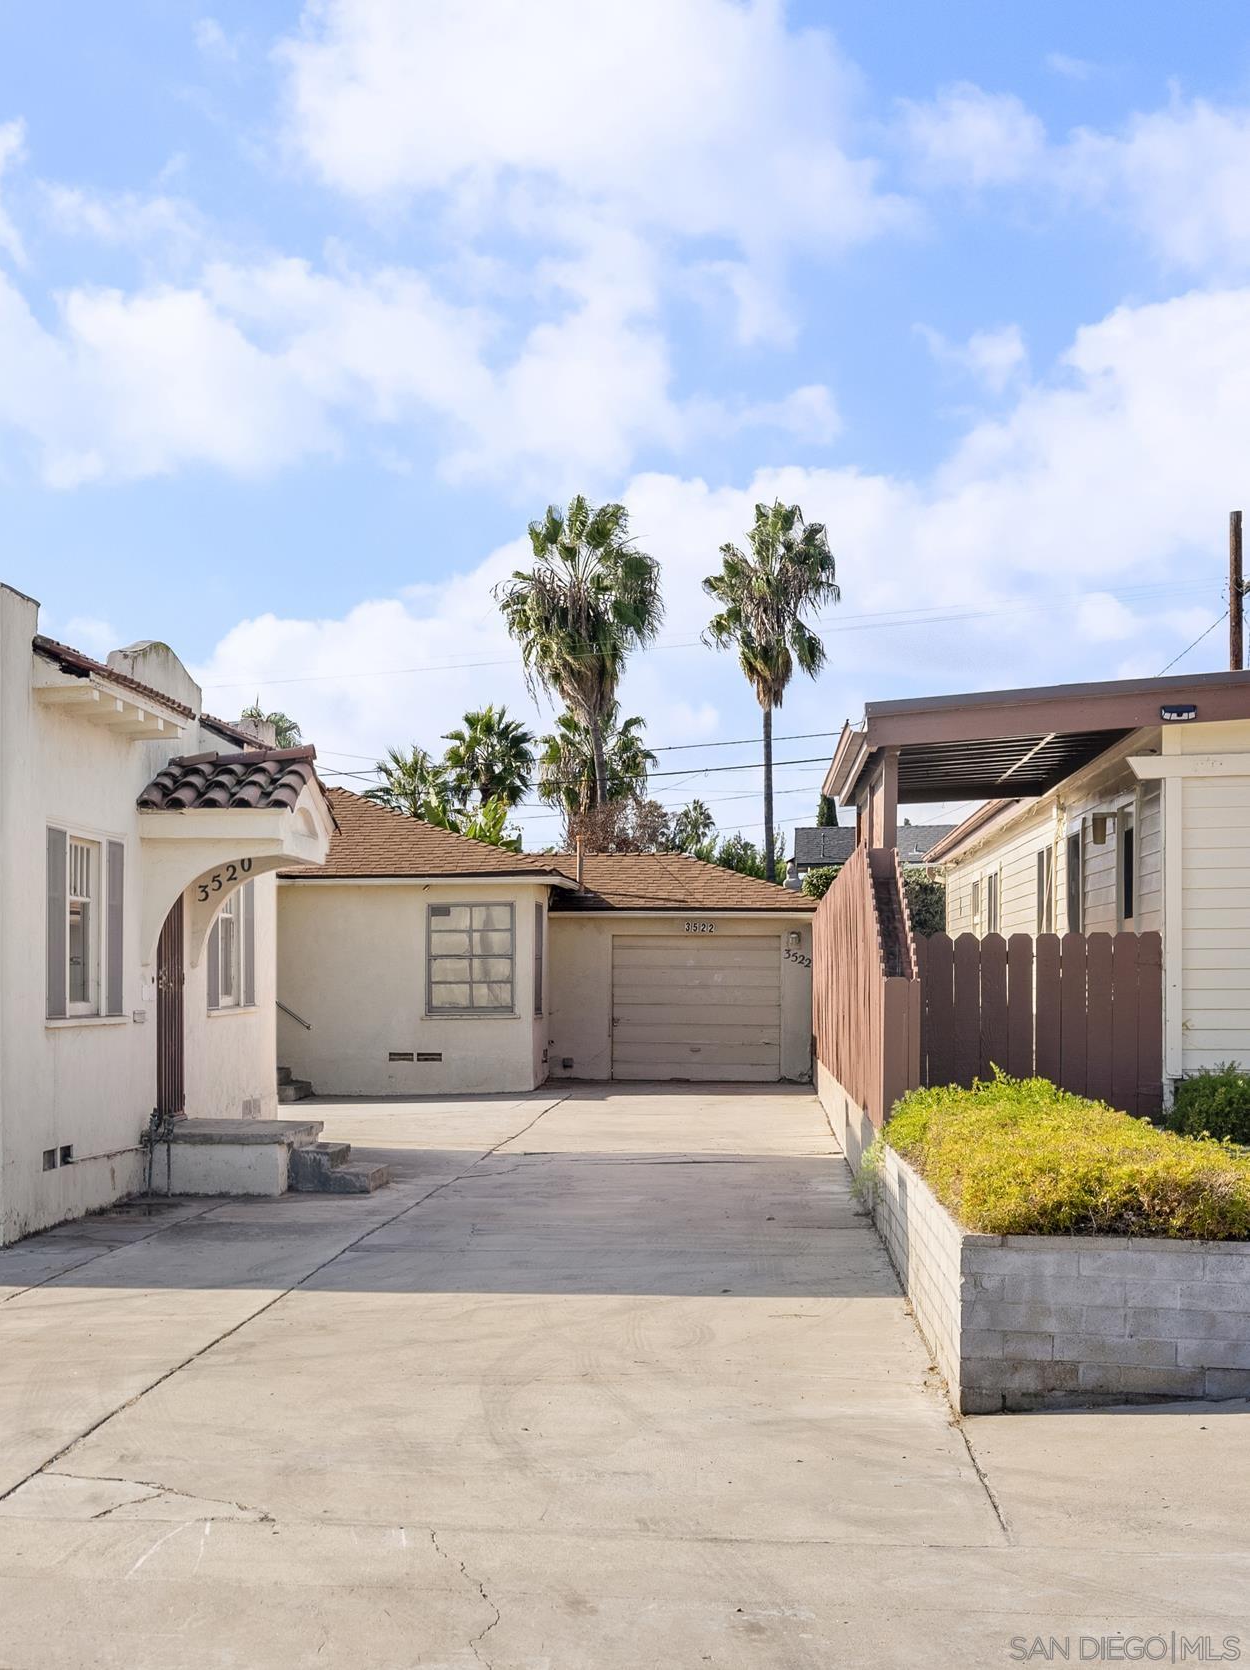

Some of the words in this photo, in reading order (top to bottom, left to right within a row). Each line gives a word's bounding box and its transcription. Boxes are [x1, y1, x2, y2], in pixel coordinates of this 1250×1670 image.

[198, 857, 252, 902] 3520
[685, 921, 715, 933] 3522
[783, 949, 812, 968] 3522
